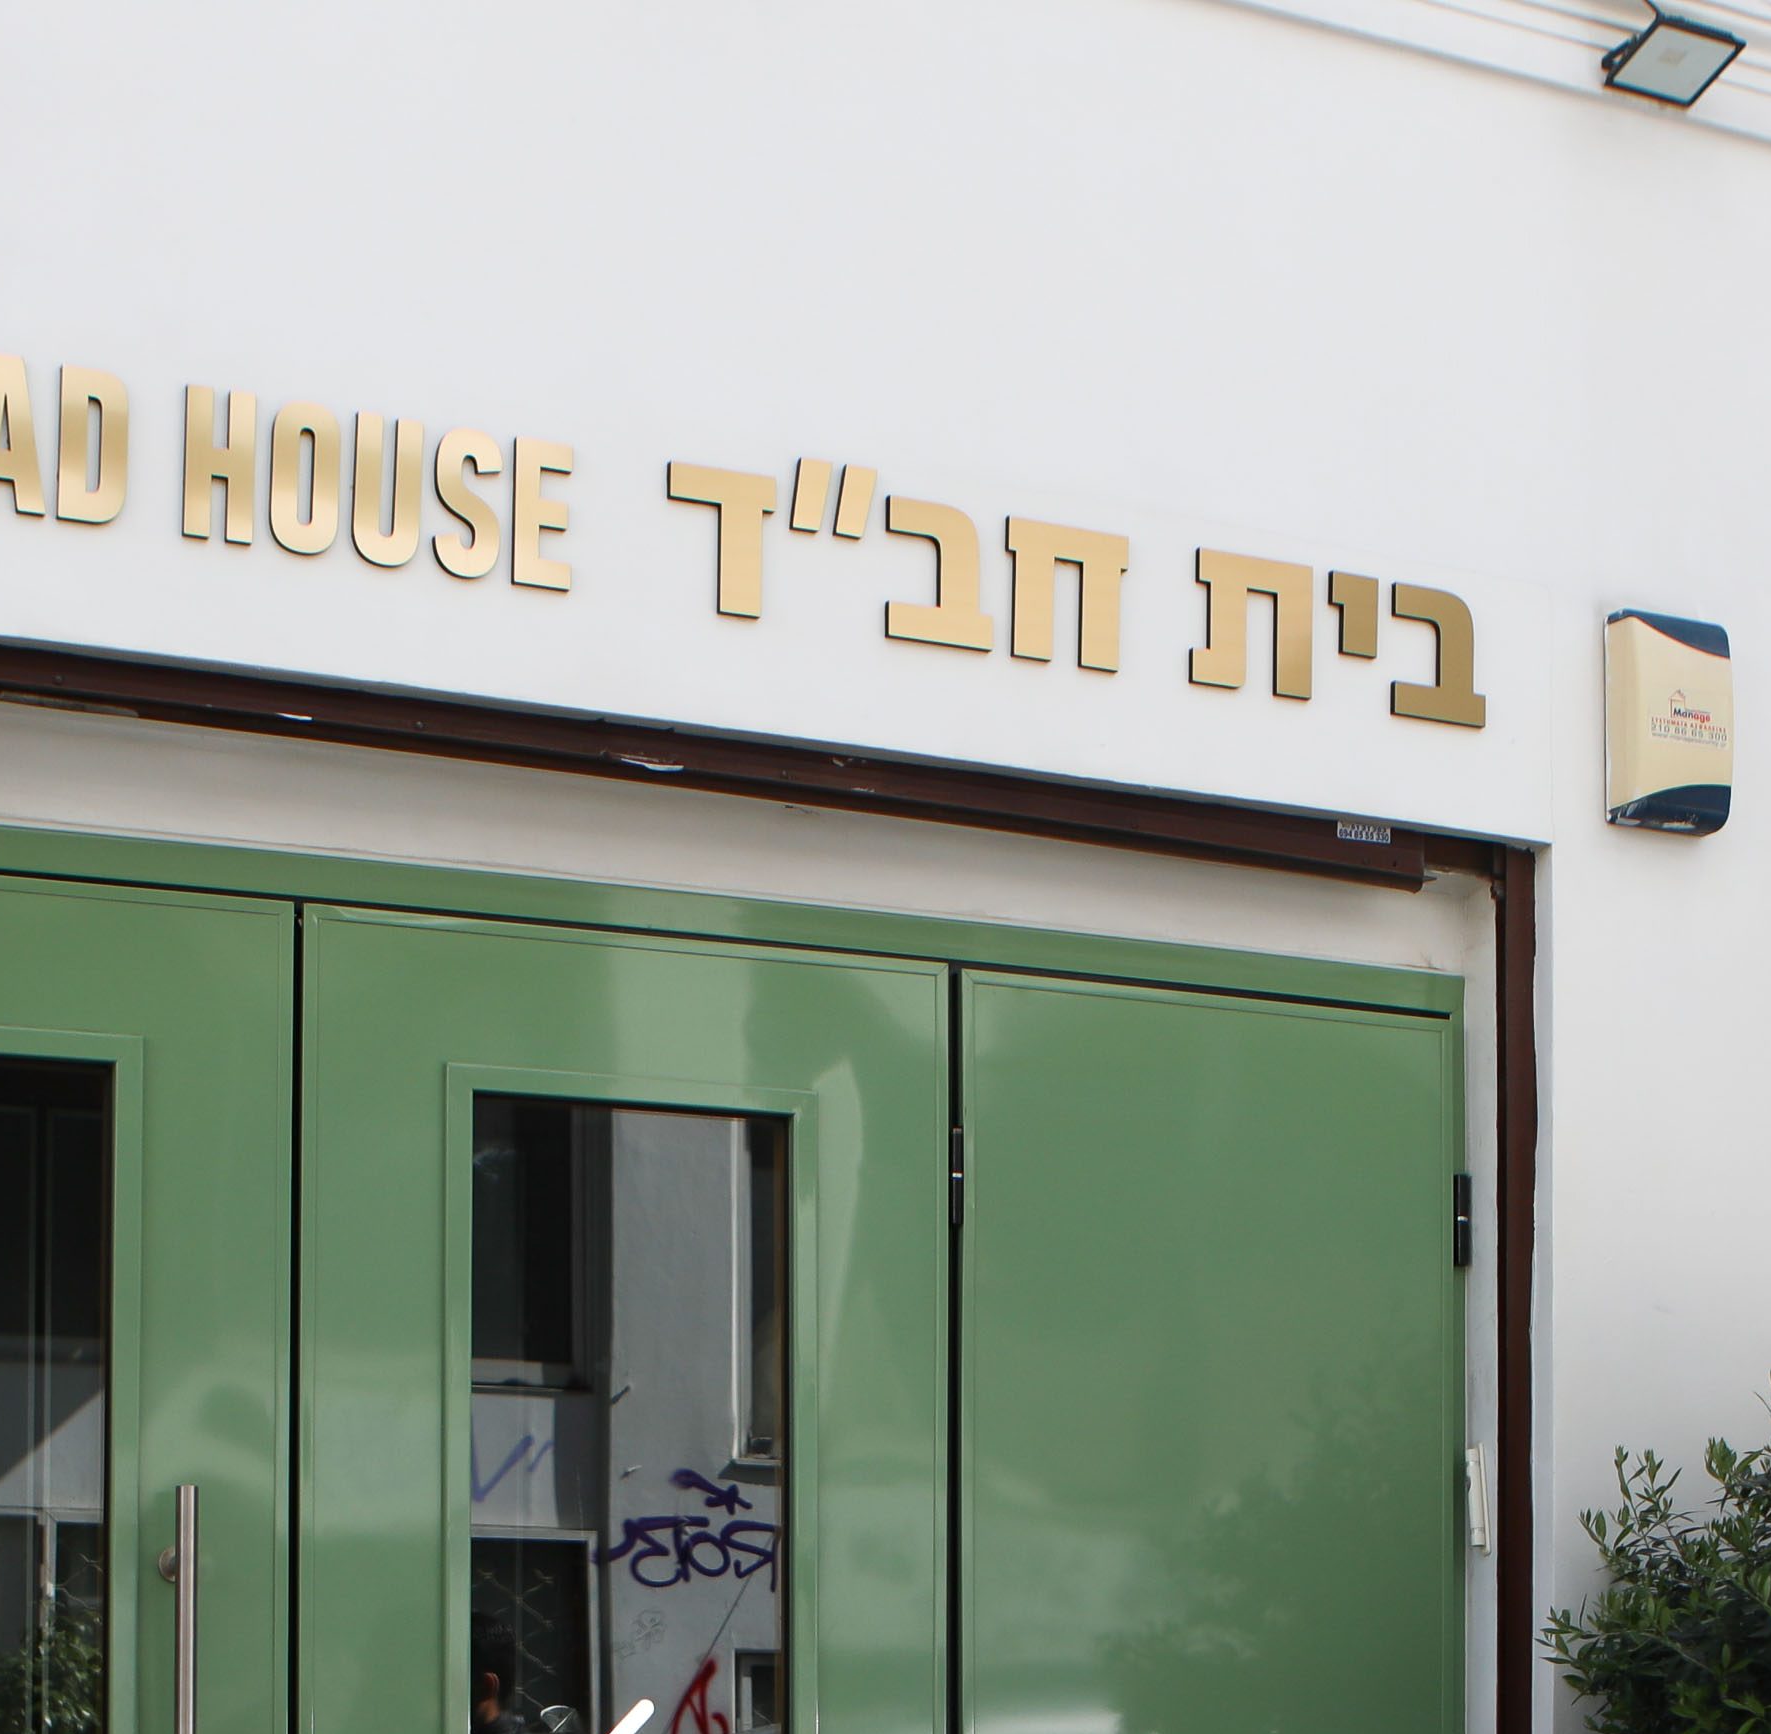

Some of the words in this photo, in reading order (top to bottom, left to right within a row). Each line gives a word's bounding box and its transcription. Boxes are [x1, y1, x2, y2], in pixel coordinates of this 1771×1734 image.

[181, 383, 574, 592] HOUSE
[1188, 546, 1486, 729] בית
[1673, 707, 1711, 724] Manage
